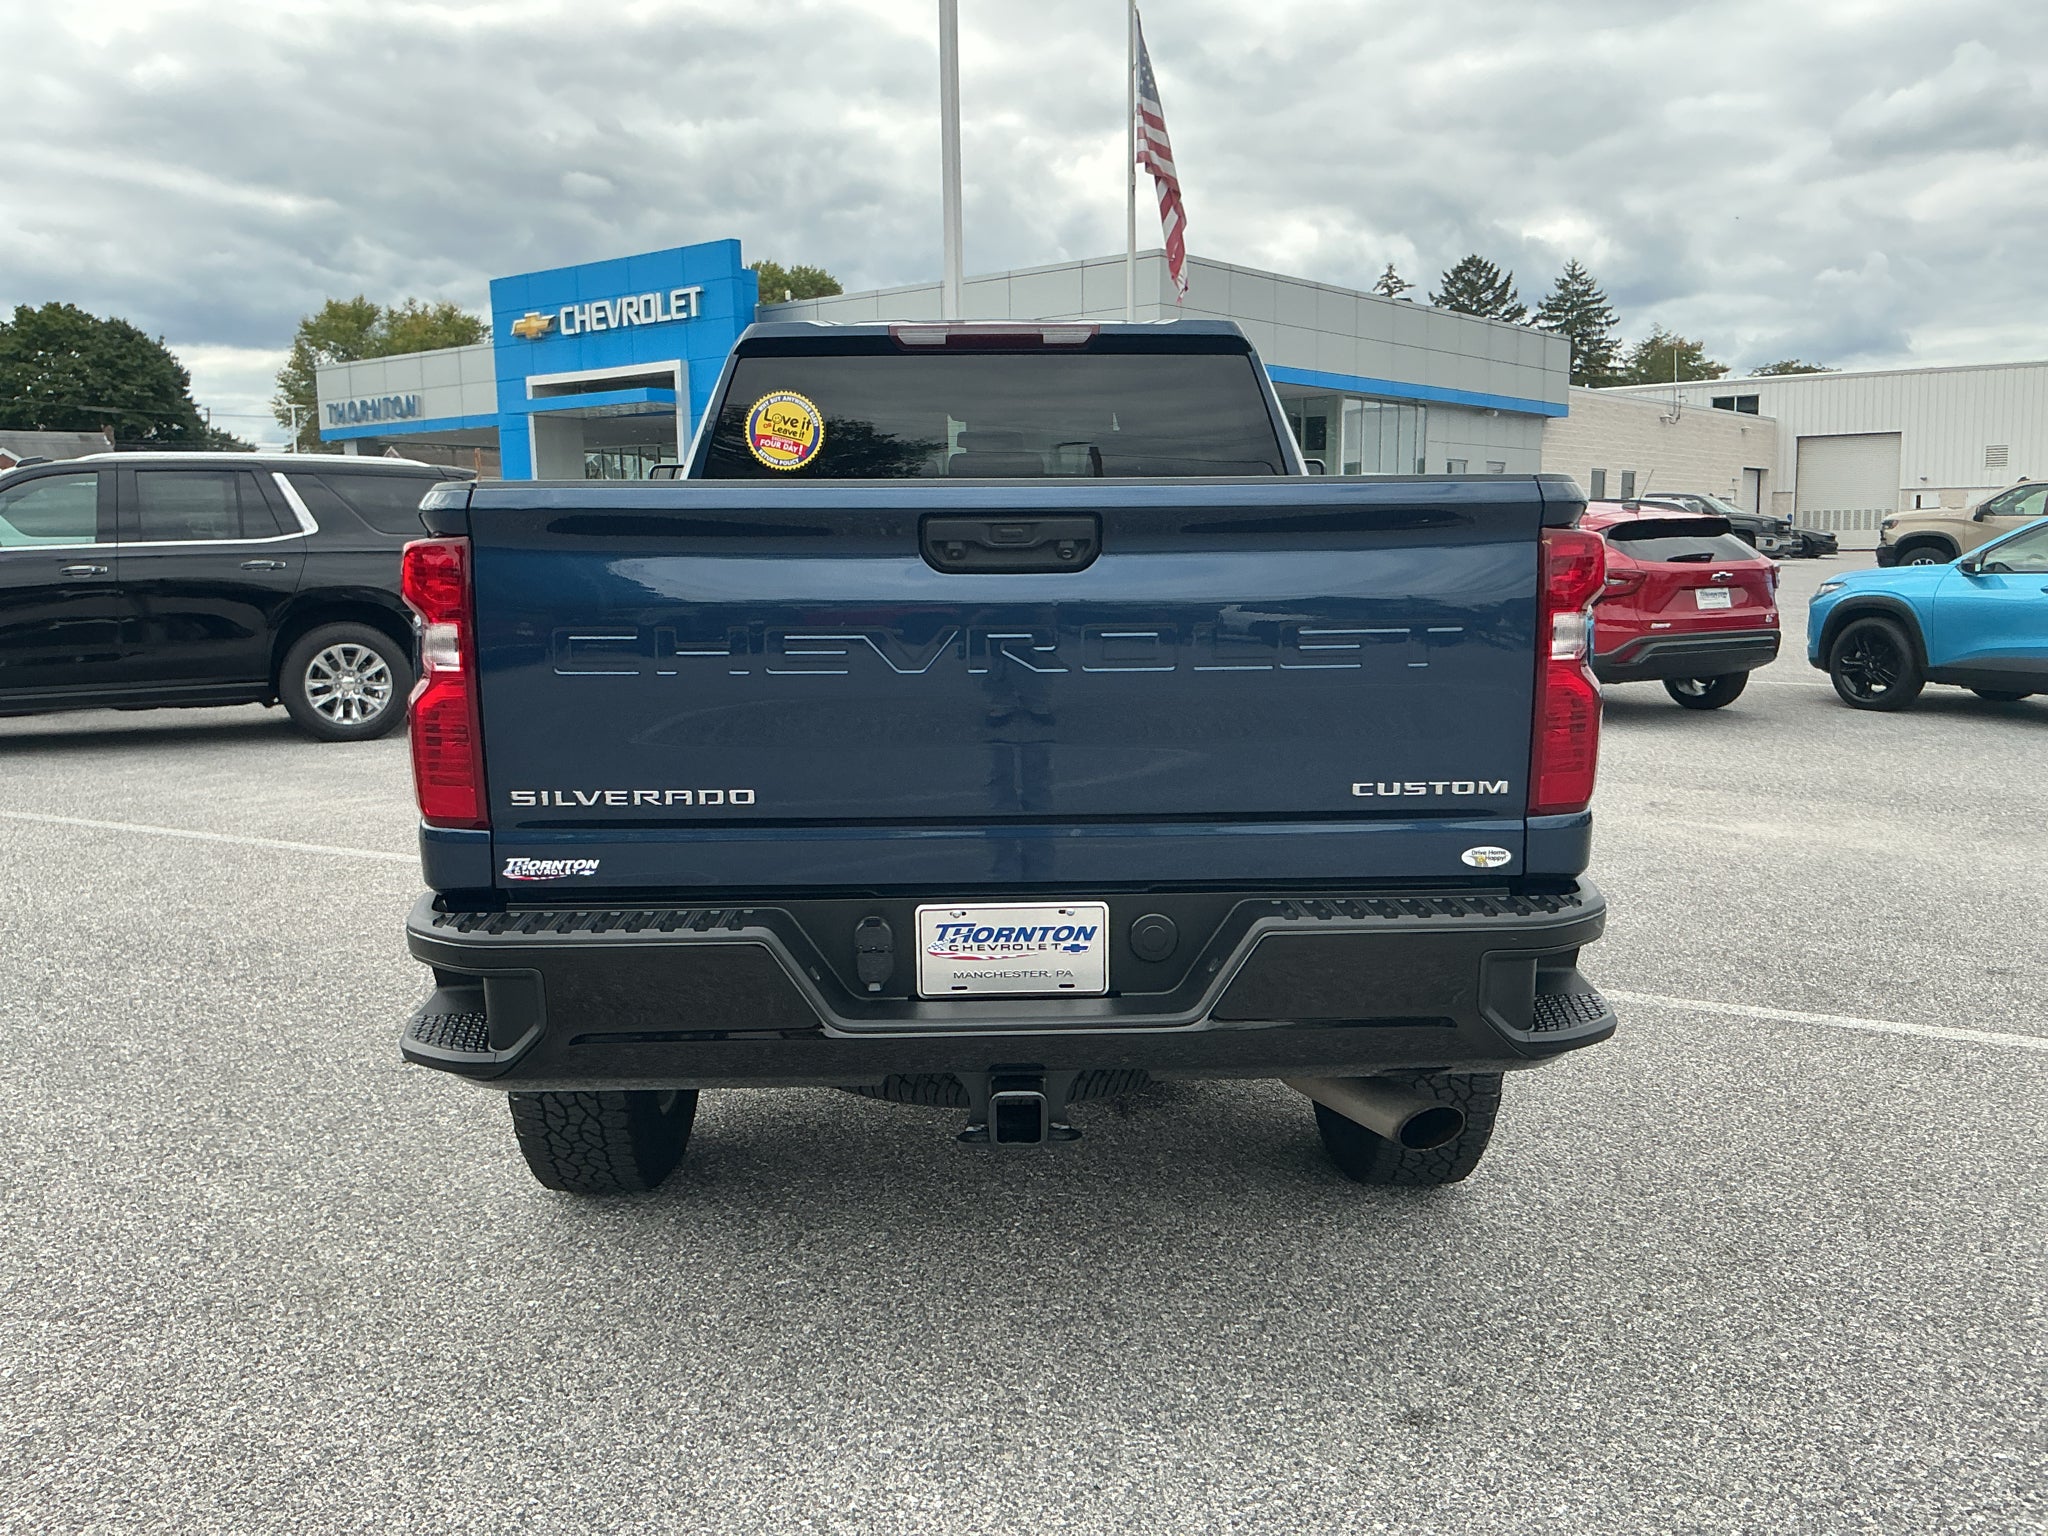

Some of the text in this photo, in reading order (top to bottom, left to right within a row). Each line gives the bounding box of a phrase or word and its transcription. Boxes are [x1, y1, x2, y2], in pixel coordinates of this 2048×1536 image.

[560, 286, 703, 336] CHEVROLET
[326, 395, 420, 424] THORNTON
[764, 408, 812, 431] Love it
[772, 423, 798, 436] Leave
[799, 430, 805, 439] it
[760, 439, 781, 449] FOUR
[758, 449, 799, 466] RETURN POLICY
[554, 624, 1464, 676] CHEVROLET
[1352, 780, 1509, 796] CUSTOM
[510, 790, 756, 806] SILVERADO
[505, 858, 600, 870] THORNTON
[935, 923, 1098, 943] THORNTON
[948, 943, 1061, 952] CHEVROLET
[953, 970, 1073, 979] MANCHESTER, PA
